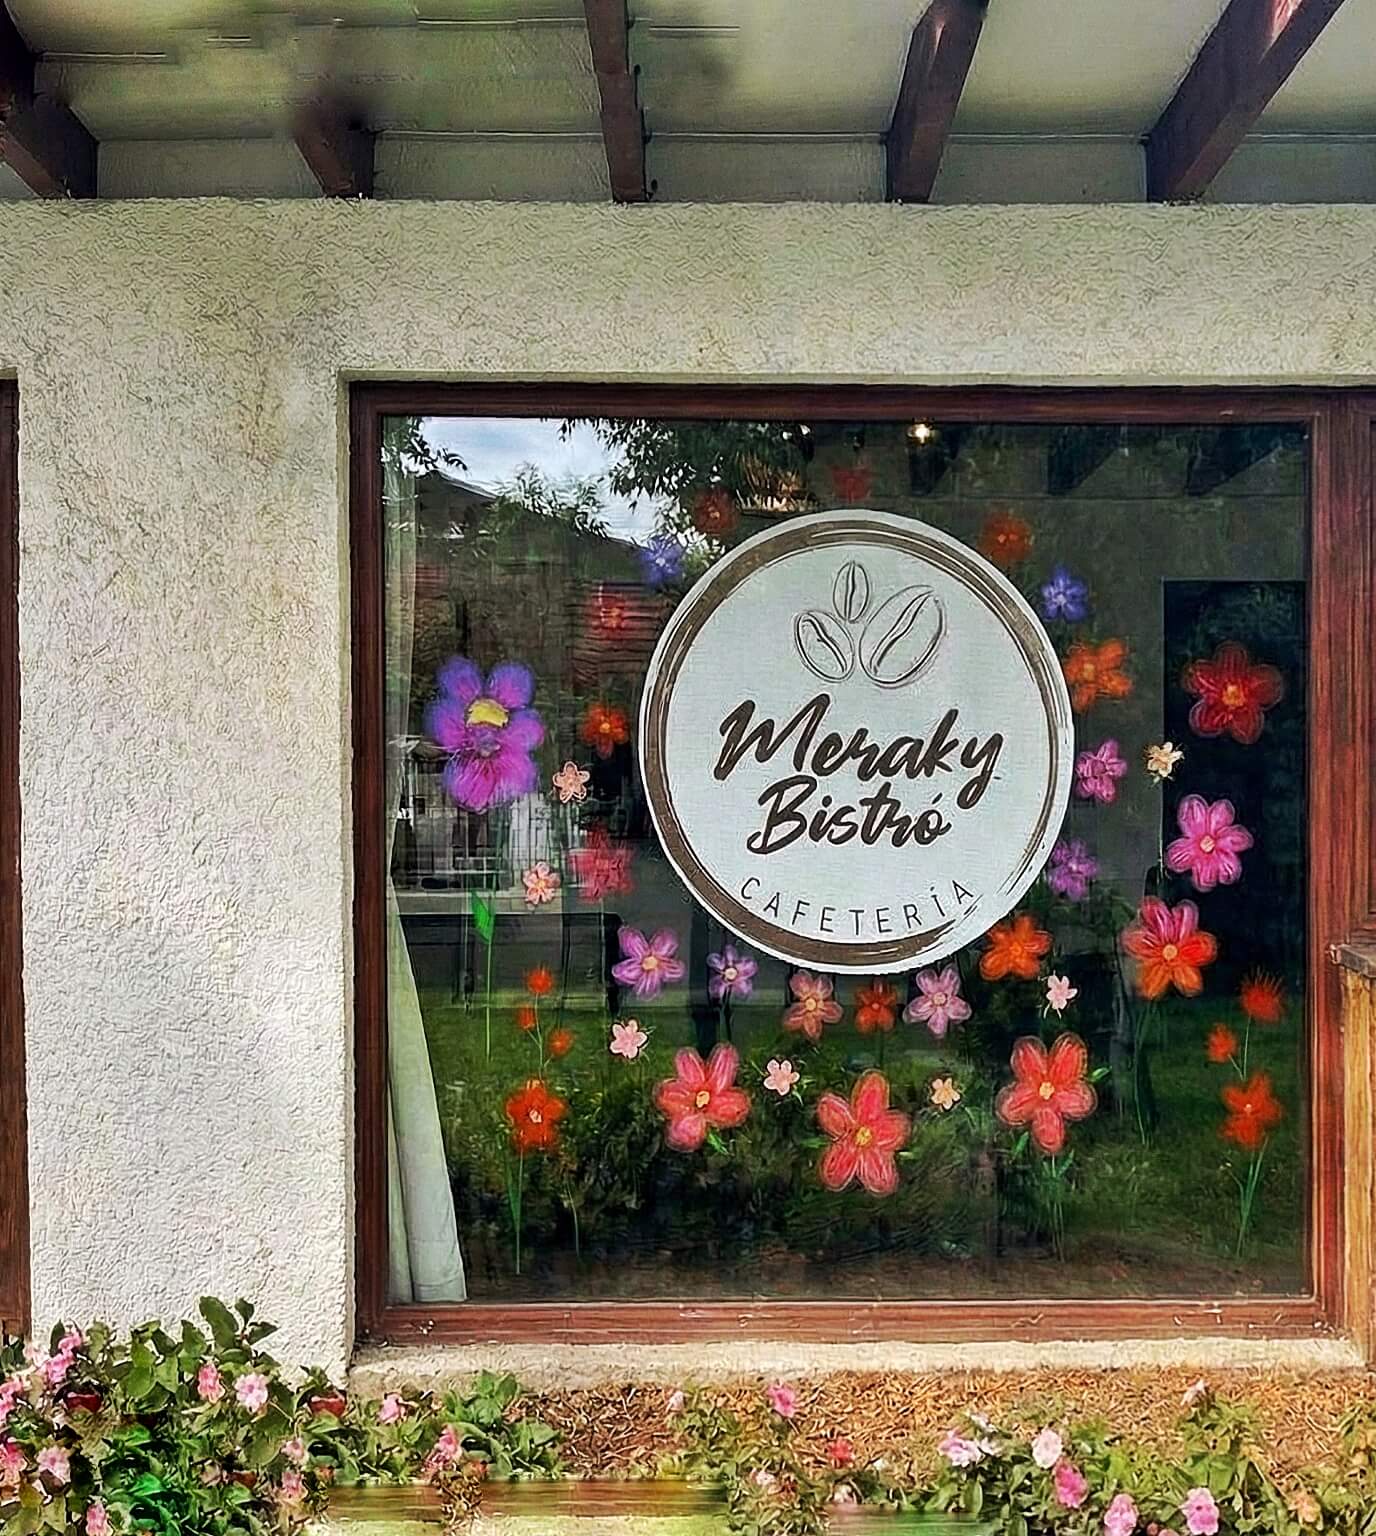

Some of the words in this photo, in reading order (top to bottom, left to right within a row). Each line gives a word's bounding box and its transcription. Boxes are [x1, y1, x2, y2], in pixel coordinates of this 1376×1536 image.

[714, 693, 1003, 809] Meraky
[747, 775, 952, 854] Bistró
[740, 877, 974, 935] CAFETERÍA
